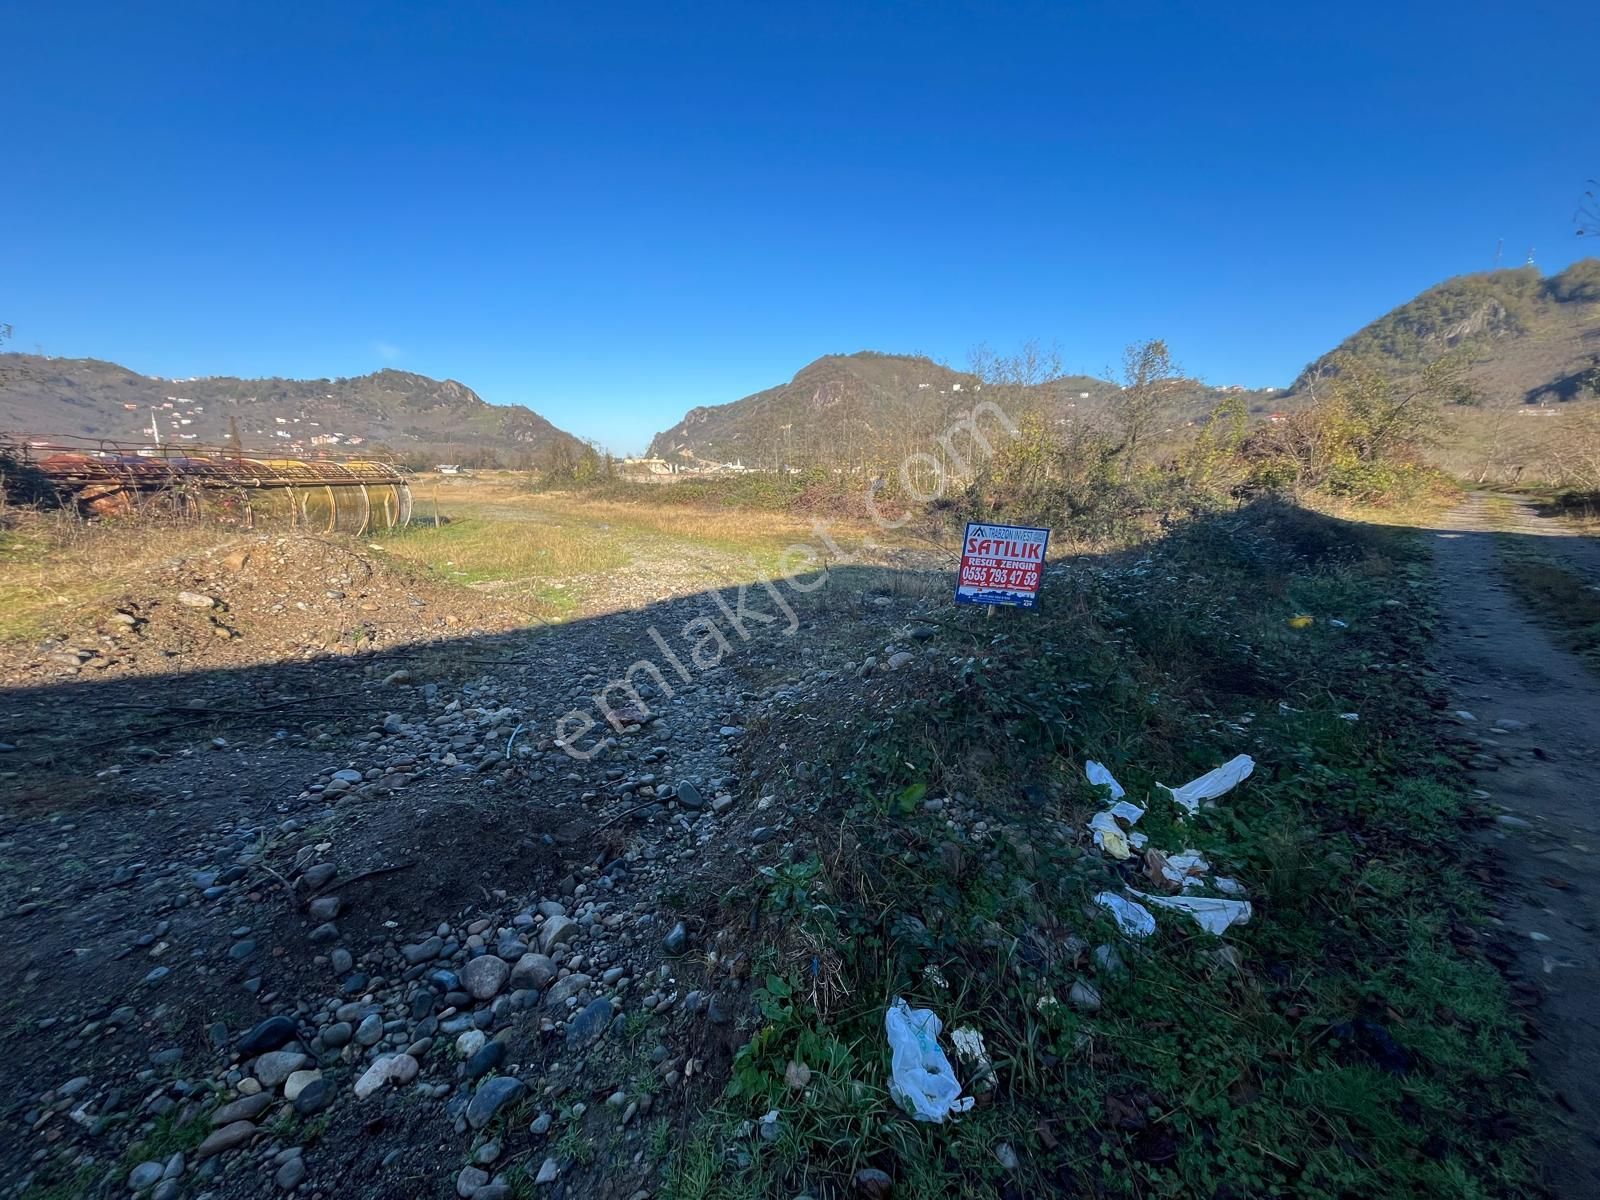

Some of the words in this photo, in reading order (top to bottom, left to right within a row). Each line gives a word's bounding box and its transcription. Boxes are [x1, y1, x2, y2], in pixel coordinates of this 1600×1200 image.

[989, 528, 1013, 539] TRABZON
[967, 538, 1041, 559] SATILIK
[968, 558, 997, 567] RESUL
[963, 566, 987, 581] 0535
[989, 568, 1008, 583] 793
[1009, 570, 1023, 584] 47
[1024, 572, 1037, 586] 52
